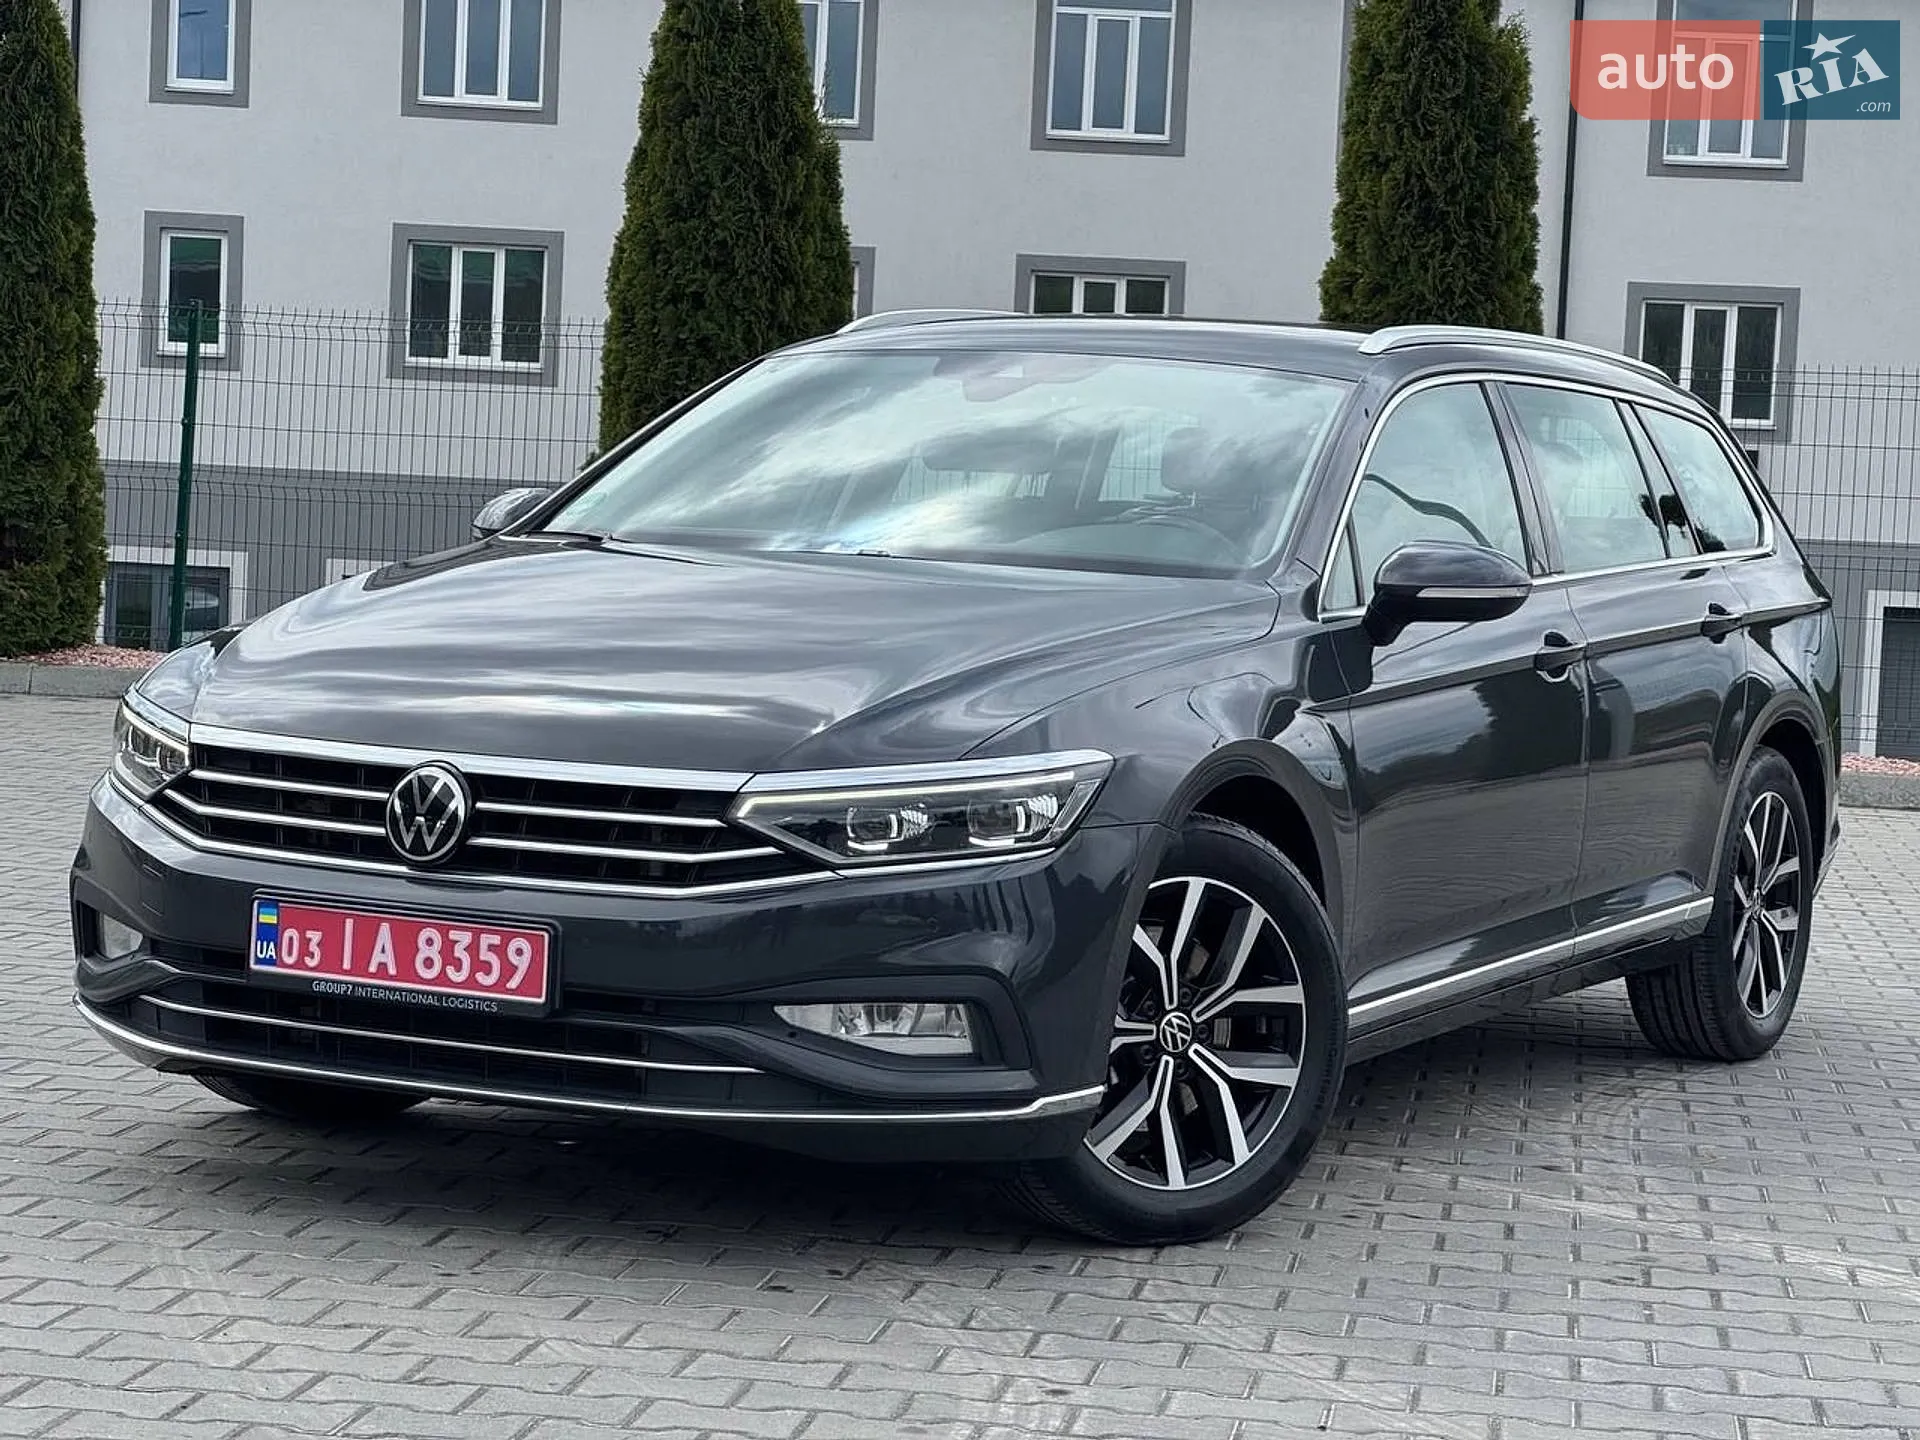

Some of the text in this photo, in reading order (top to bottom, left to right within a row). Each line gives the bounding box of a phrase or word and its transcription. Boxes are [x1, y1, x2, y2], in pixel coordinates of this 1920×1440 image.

[256, 939, 277, 960] UA
[280, 927, 324, 968] 03
[414, 926, 534, 991] 8359
[354, 985, 440, 1006] INTERNATIONAL
[442, 996, 498, 1012] LOGISTICS
